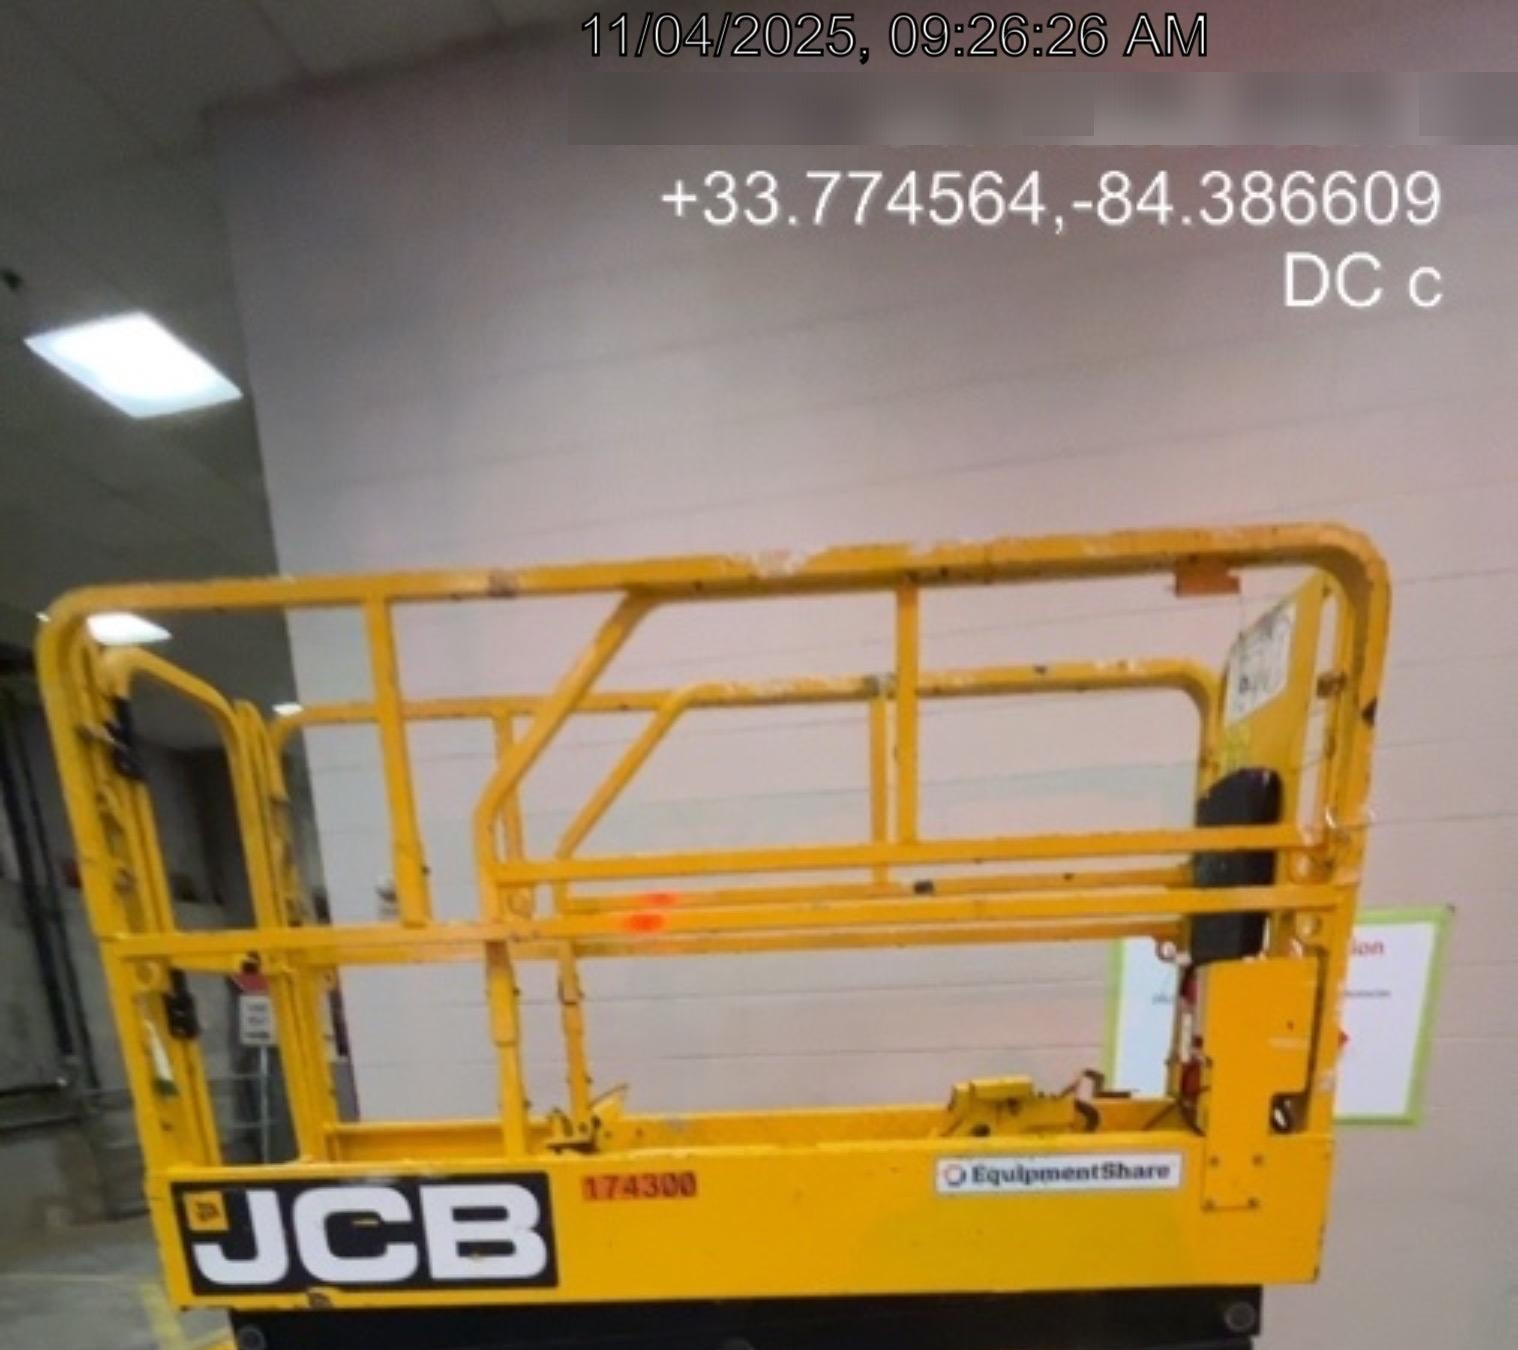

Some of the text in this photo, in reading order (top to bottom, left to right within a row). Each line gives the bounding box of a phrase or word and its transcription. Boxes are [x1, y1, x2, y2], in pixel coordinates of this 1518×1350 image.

[583, 1171, 698, 1200] 174300
[971, 1161, 1171, 1186] EquipmentShare
[191, 1184, 548, 1286] JCB
